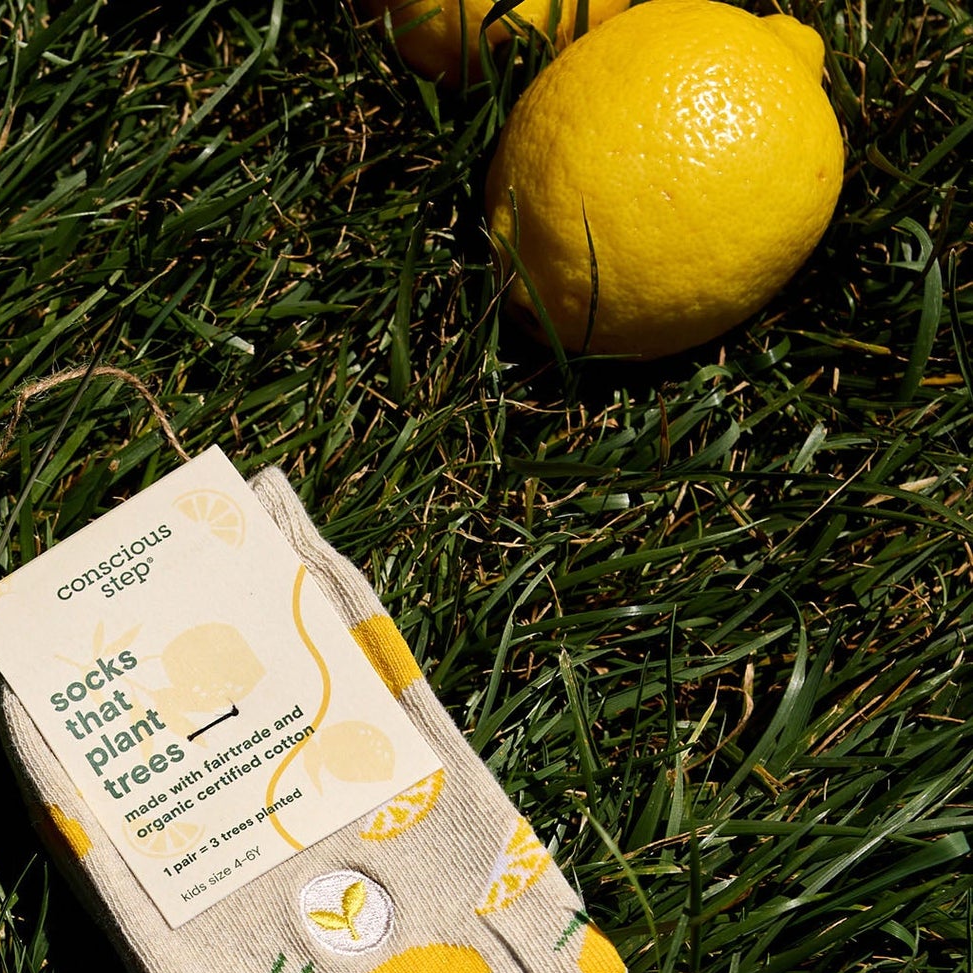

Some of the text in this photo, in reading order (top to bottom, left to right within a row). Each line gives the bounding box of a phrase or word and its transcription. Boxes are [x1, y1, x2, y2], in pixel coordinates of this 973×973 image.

[57, 524, 172, 601] conscious
[50, 650, 138, 713] socks
[65, 689, 134, 740] that
[84, 708, 167, 777] plant
[103, 743, 186, 800] trees
[124, 704, 304, 823] made with fairtrade and
[137, 725, 316, 838] organic certified cotton
[163, 787, 303, 877] 1 pair = 3 trees planted
[180, 883, 208, 903] kids
[208, 867, 233, 886] size
